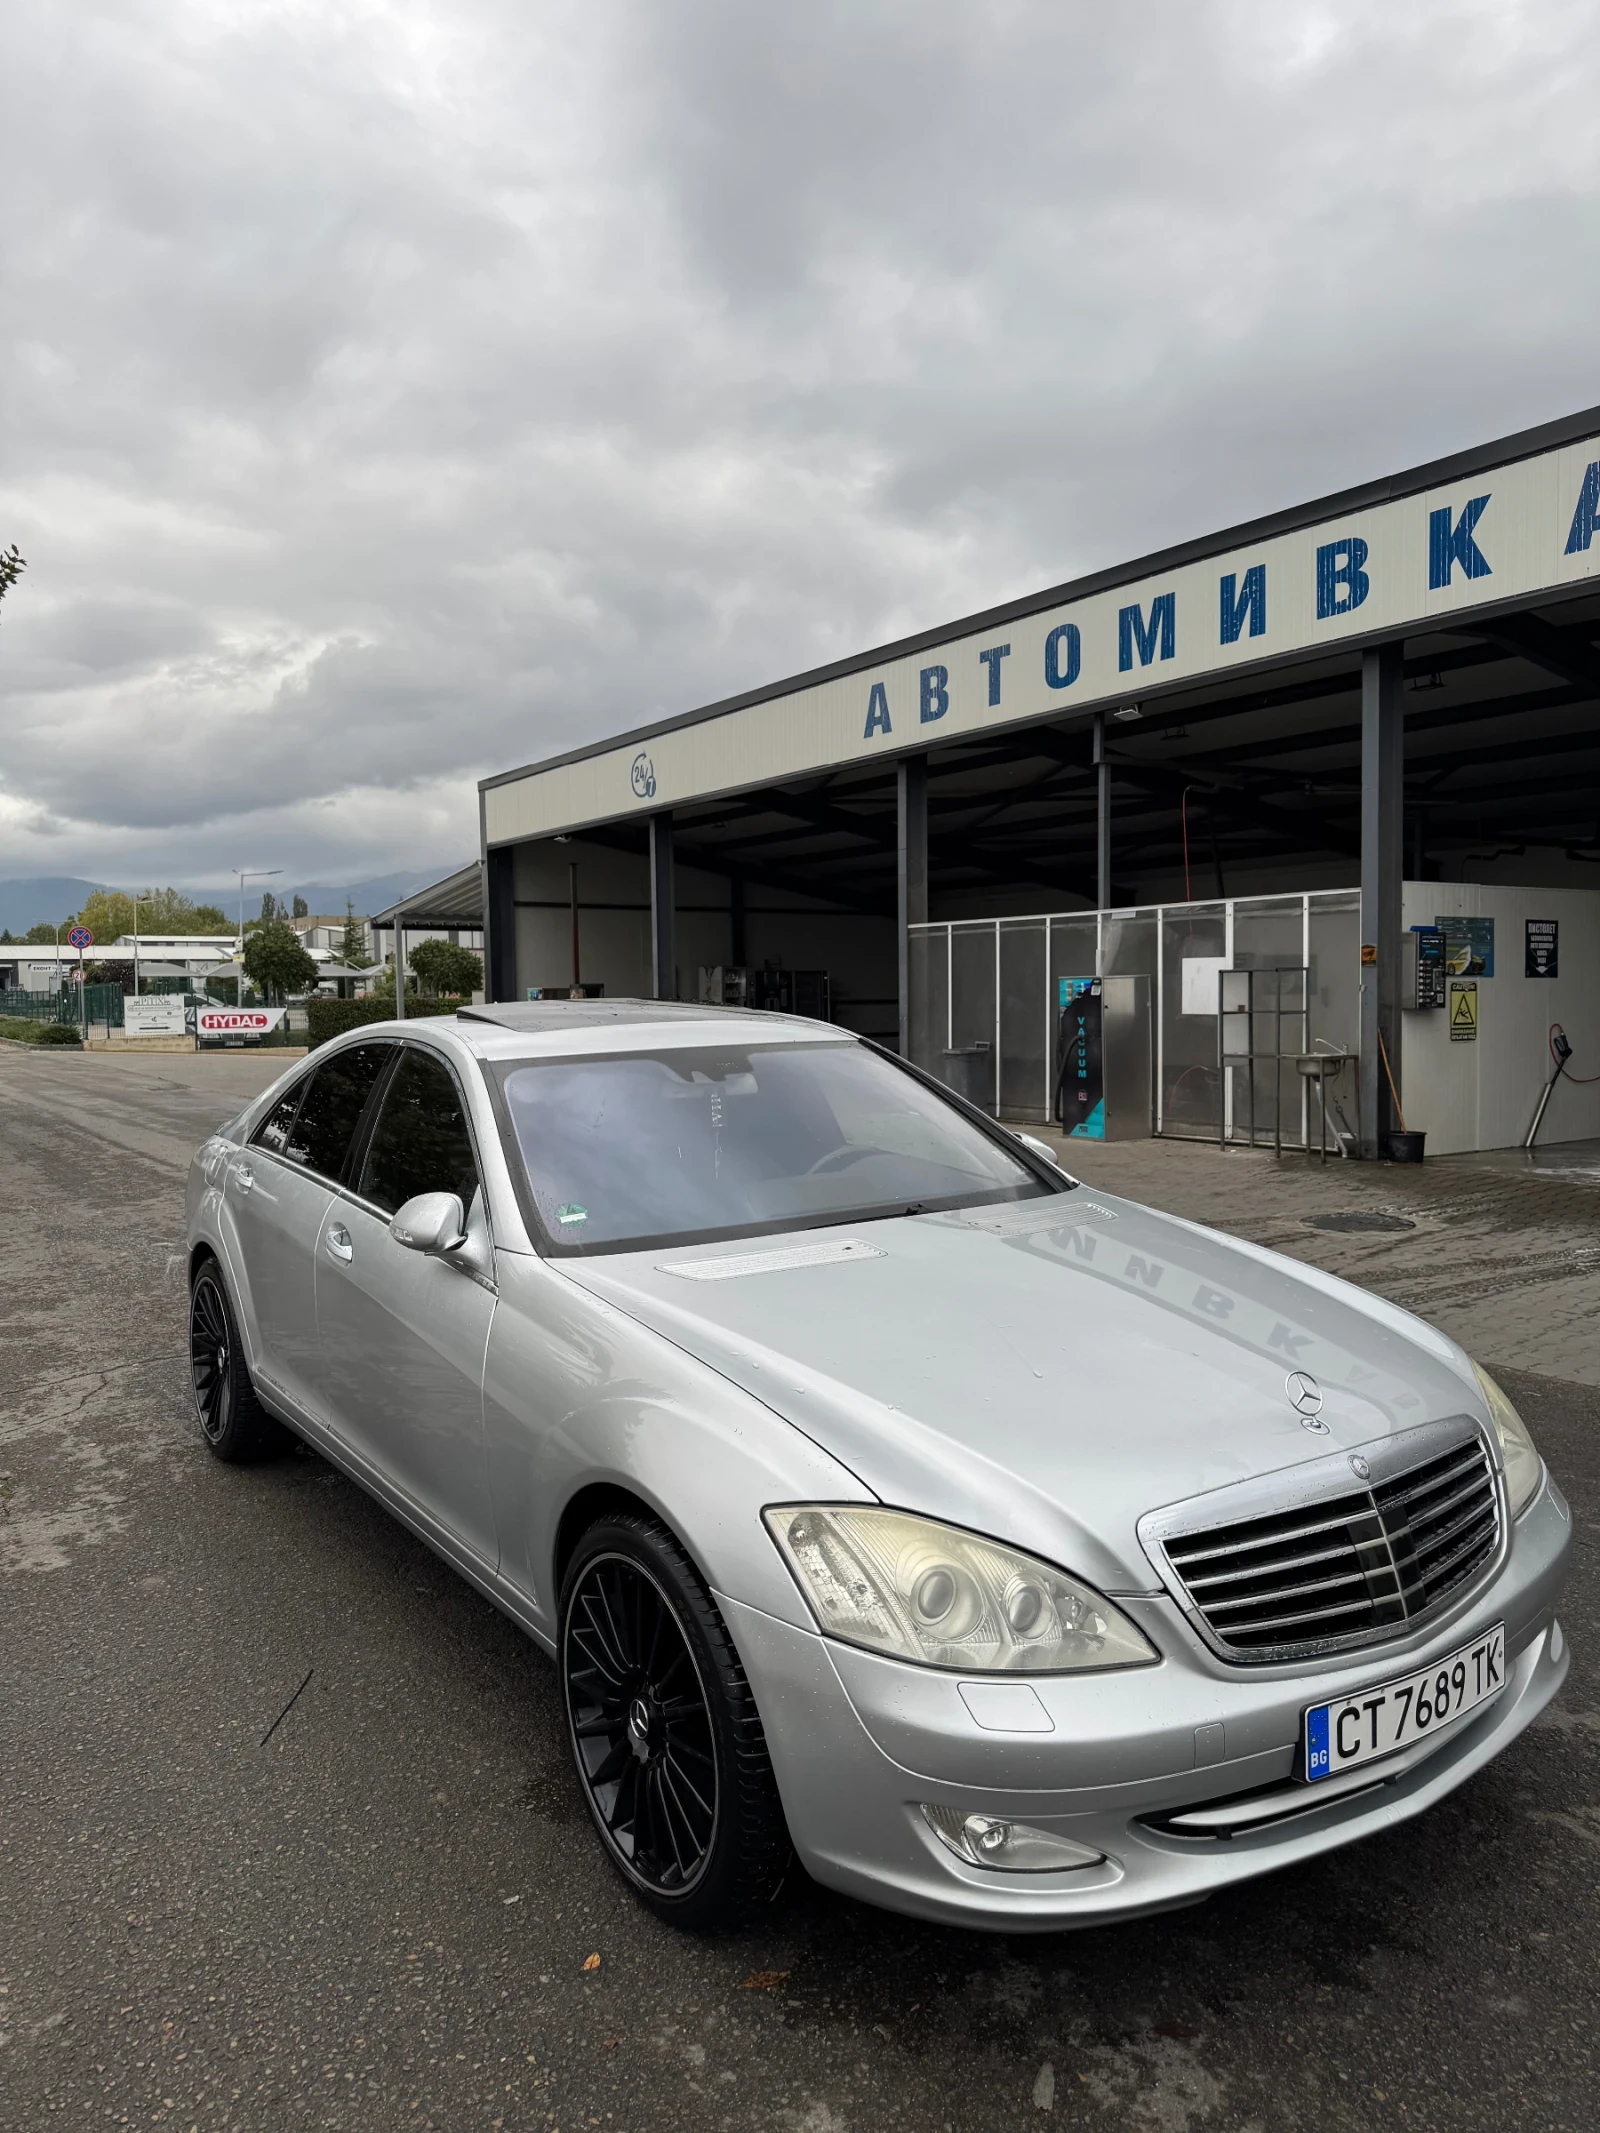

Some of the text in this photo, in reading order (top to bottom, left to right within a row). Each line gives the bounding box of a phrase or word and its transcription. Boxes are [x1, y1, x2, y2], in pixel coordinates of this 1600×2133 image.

[635, 765, 654, 796] 24/7
[205, 1015, 264, 1027] HYDAC
[1394, 1661, 1466, 1740] 7689
[1311, 1750, 1327, 1768] BG
